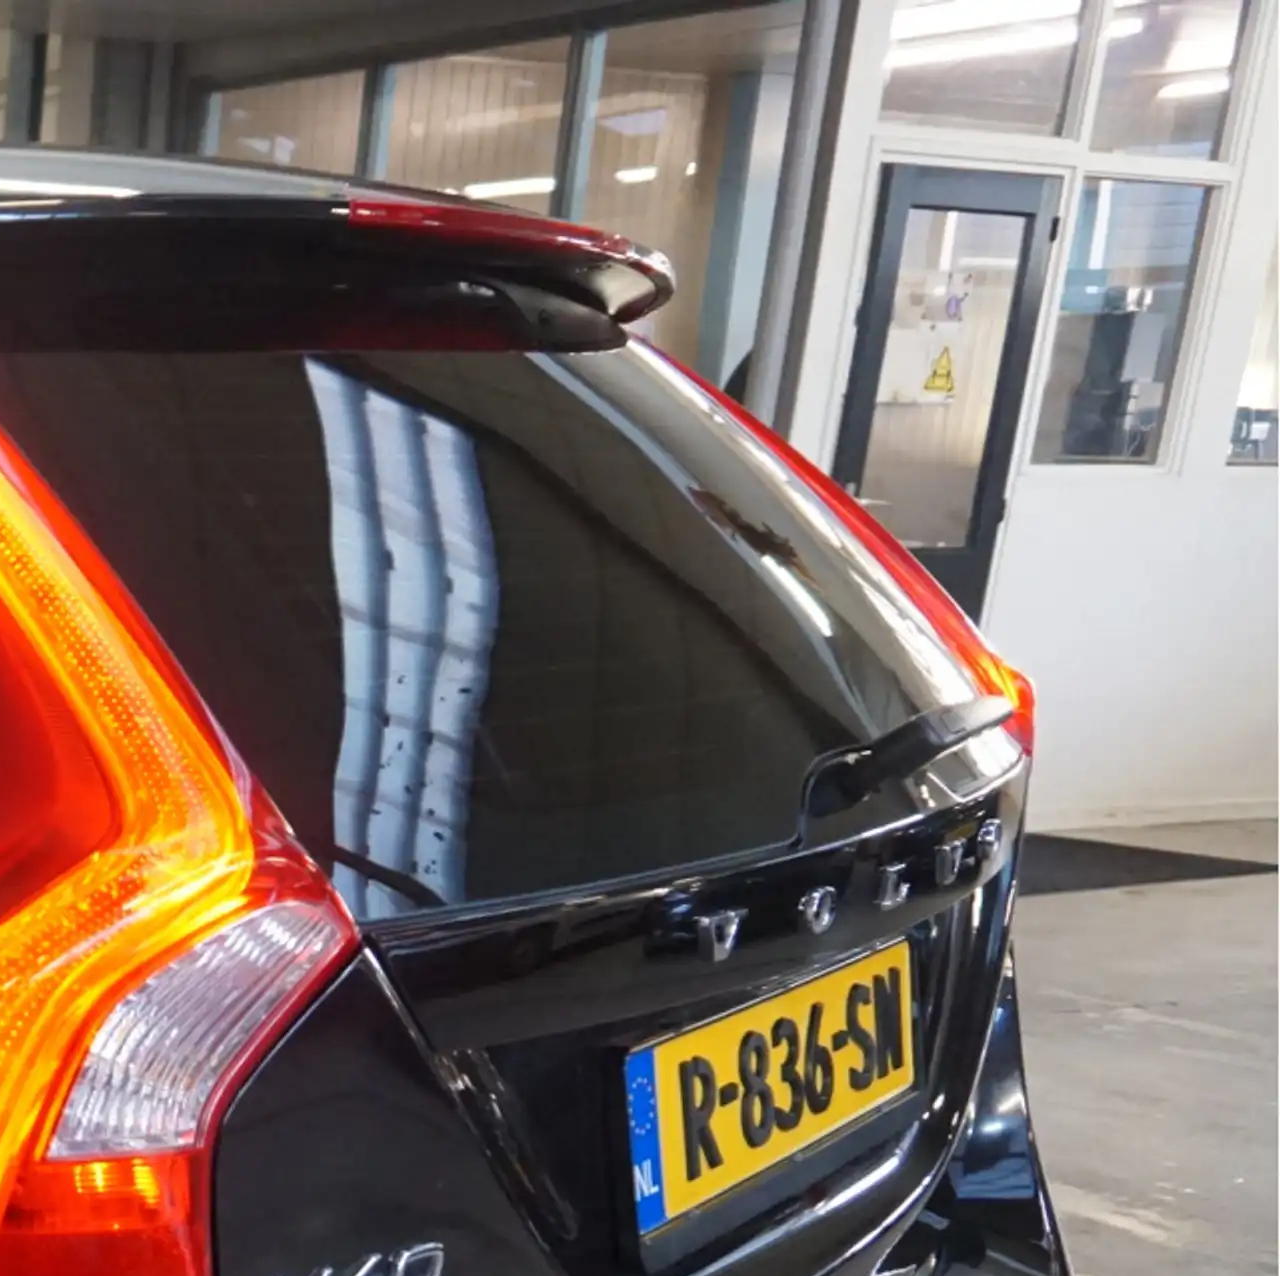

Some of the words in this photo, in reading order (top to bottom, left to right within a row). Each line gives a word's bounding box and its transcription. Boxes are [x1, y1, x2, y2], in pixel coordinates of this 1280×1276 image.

[693, 818, 1003, 962] VOLVO
[678, 966, 905, 1182] R-836-SN
[633, 1157, 660, 1203] NL
